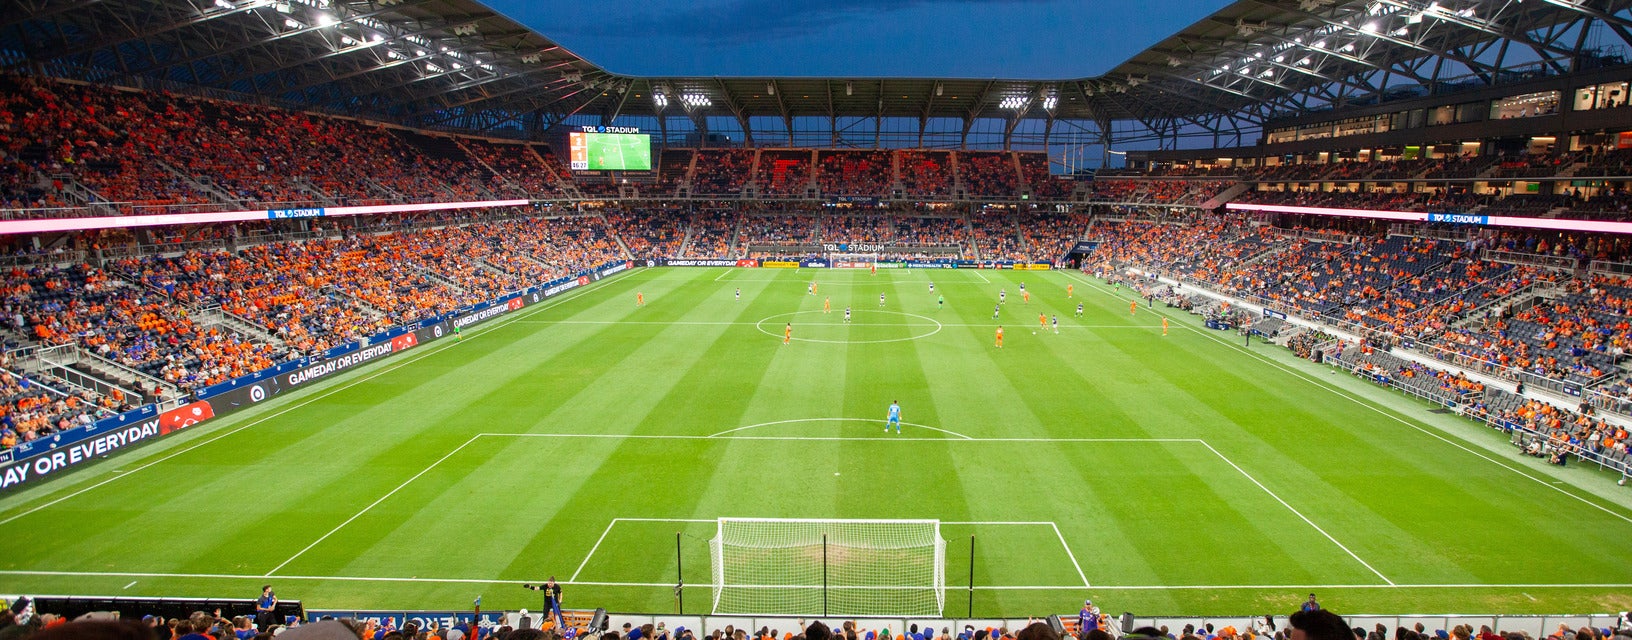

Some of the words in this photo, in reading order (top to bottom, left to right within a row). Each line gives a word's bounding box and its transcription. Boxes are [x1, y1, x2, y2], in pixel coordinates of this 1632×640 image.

[606, 126, 639, 134] STADIUM
[274, 210, 288, 218] TQL
[293, 209, 320, 217] STADIUM
[1452, 215, 1482, 224] STADIUM
[823, 244, 839, 252] TQL
[848, 244, 885, 252] STADIUM
[453, 313, 479, 328] GAMEDAY
[289, 360, 337, 385] GAMEDAY
[337, 356, 352, 370] OR
[352, 342, 392, 364] EVERYDAY
[0, 462, 31, 488] AY
[34, 451, 67, 475] OR
[69, 419, 160, 465] EVERYDAY
